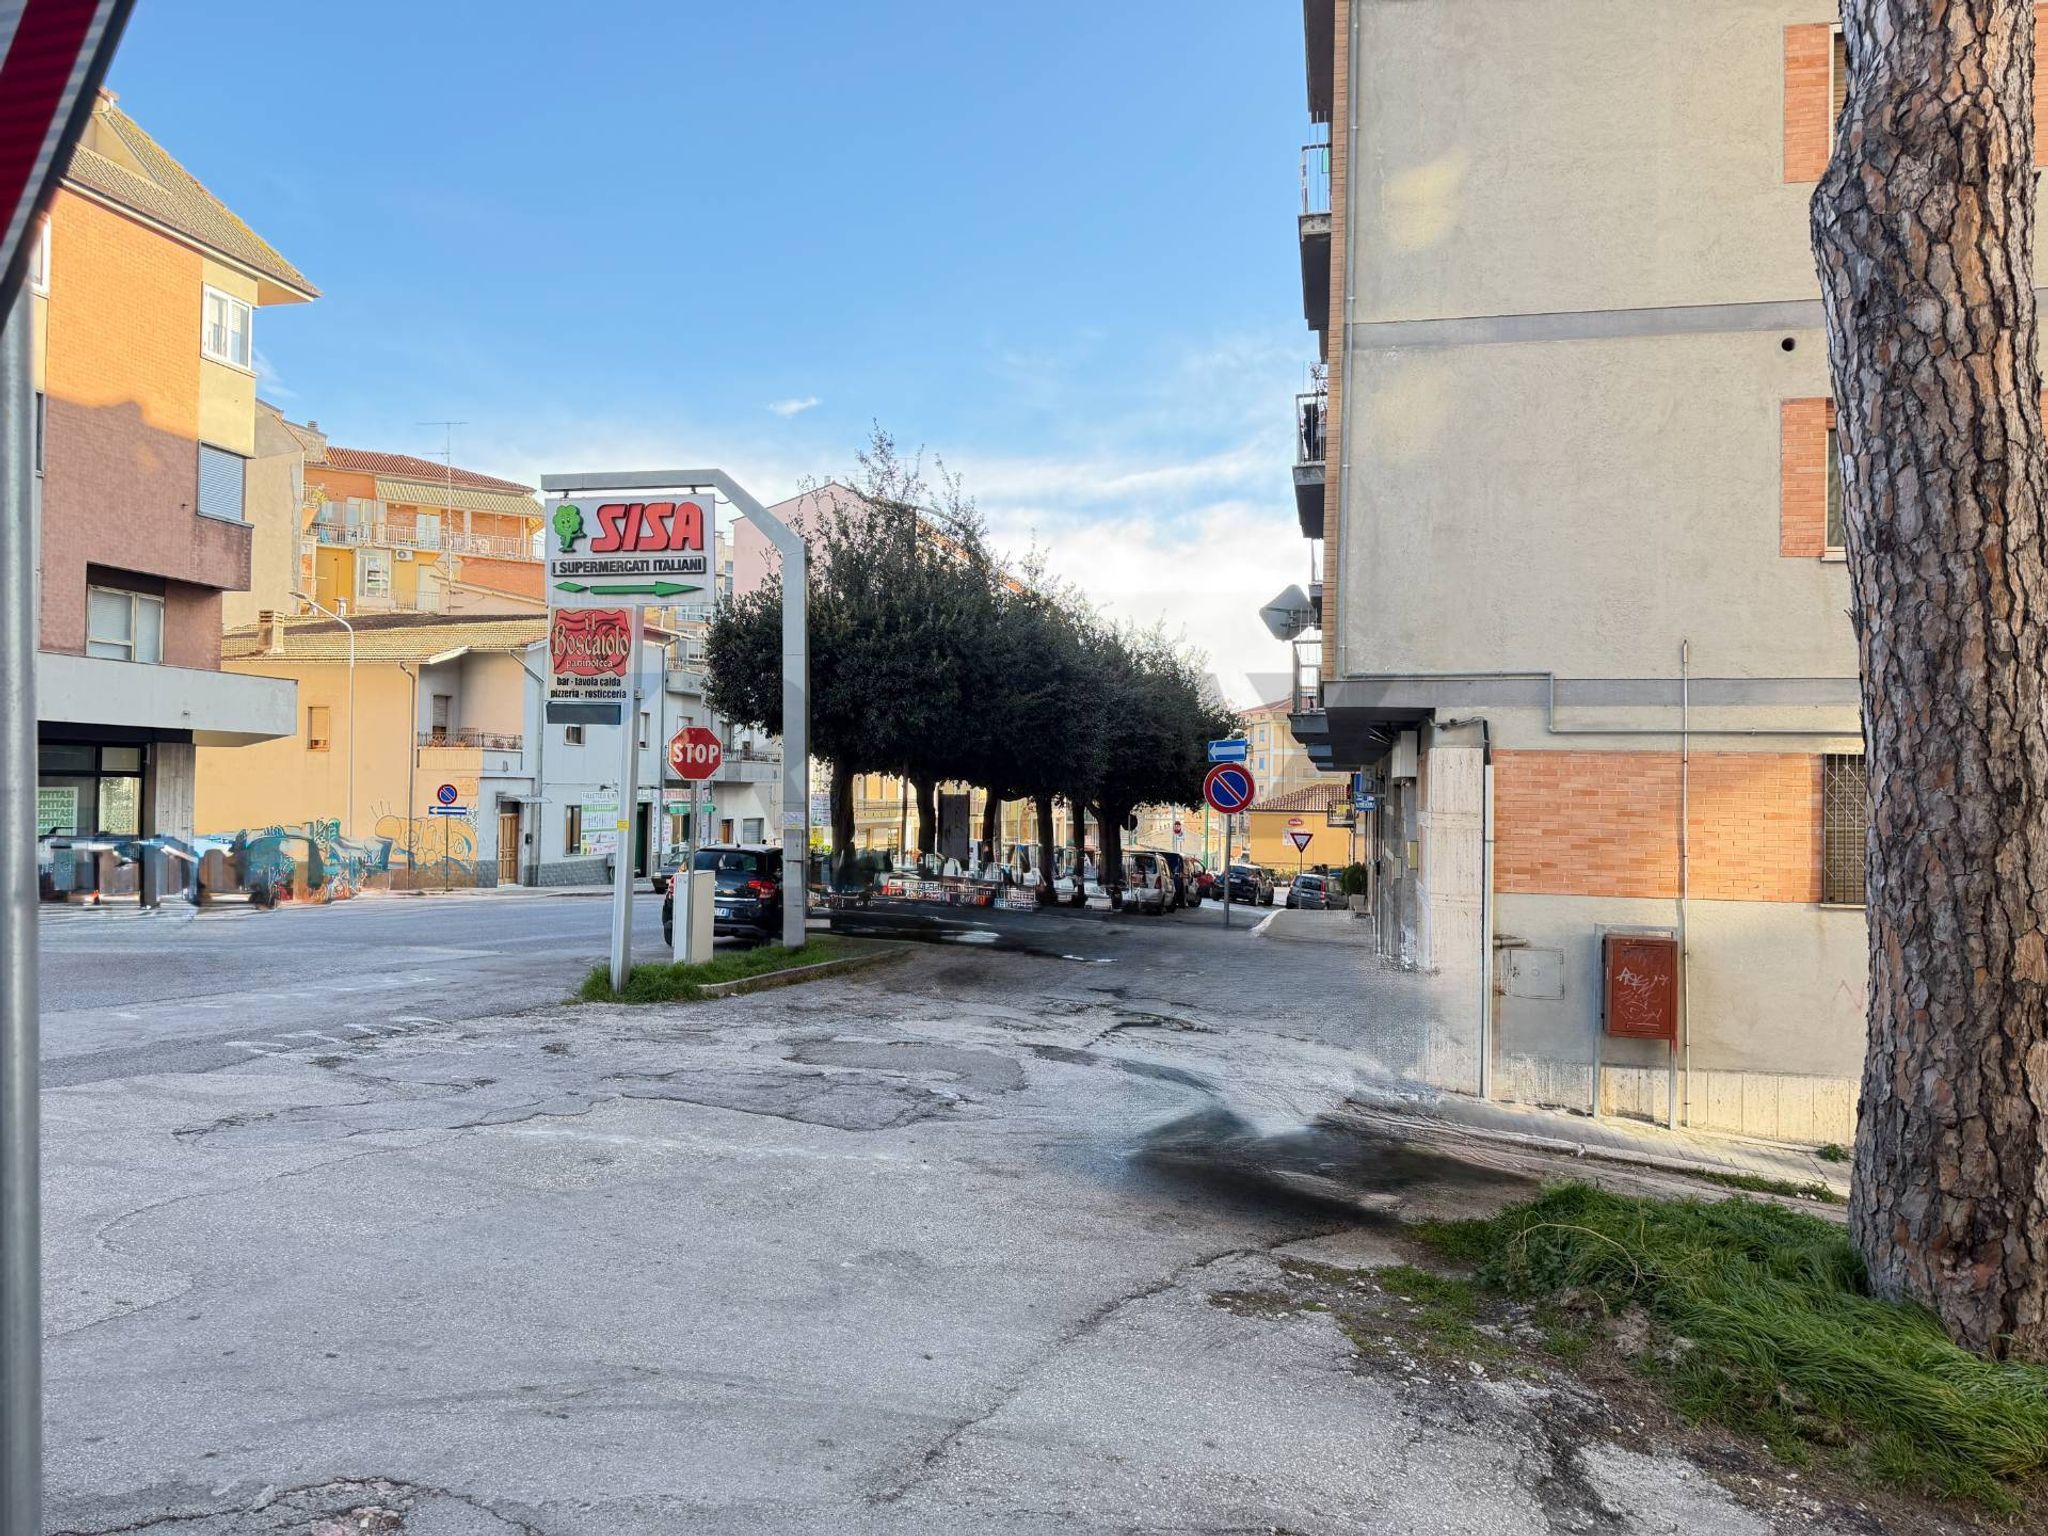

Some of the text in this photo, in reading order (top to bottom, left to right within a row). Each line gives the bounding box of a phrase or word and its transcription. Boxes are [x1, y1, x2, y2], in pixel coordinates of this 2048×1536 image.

[591, 501, 703, 553] SISA
[552, 558, 702, 574] I SUPERMERCATI ITALIANI
[553, 623, 629, 656] Boscaiolo
[556, 676, 569, 686] bar
[575, 677, 598, 687] tavola
[600, 677, 621, 687] calda
[550, 689, 580, 699] pizzeria
[585, 688, 627, 699] rosticceria
[673, 743, 719, 764] STOP
